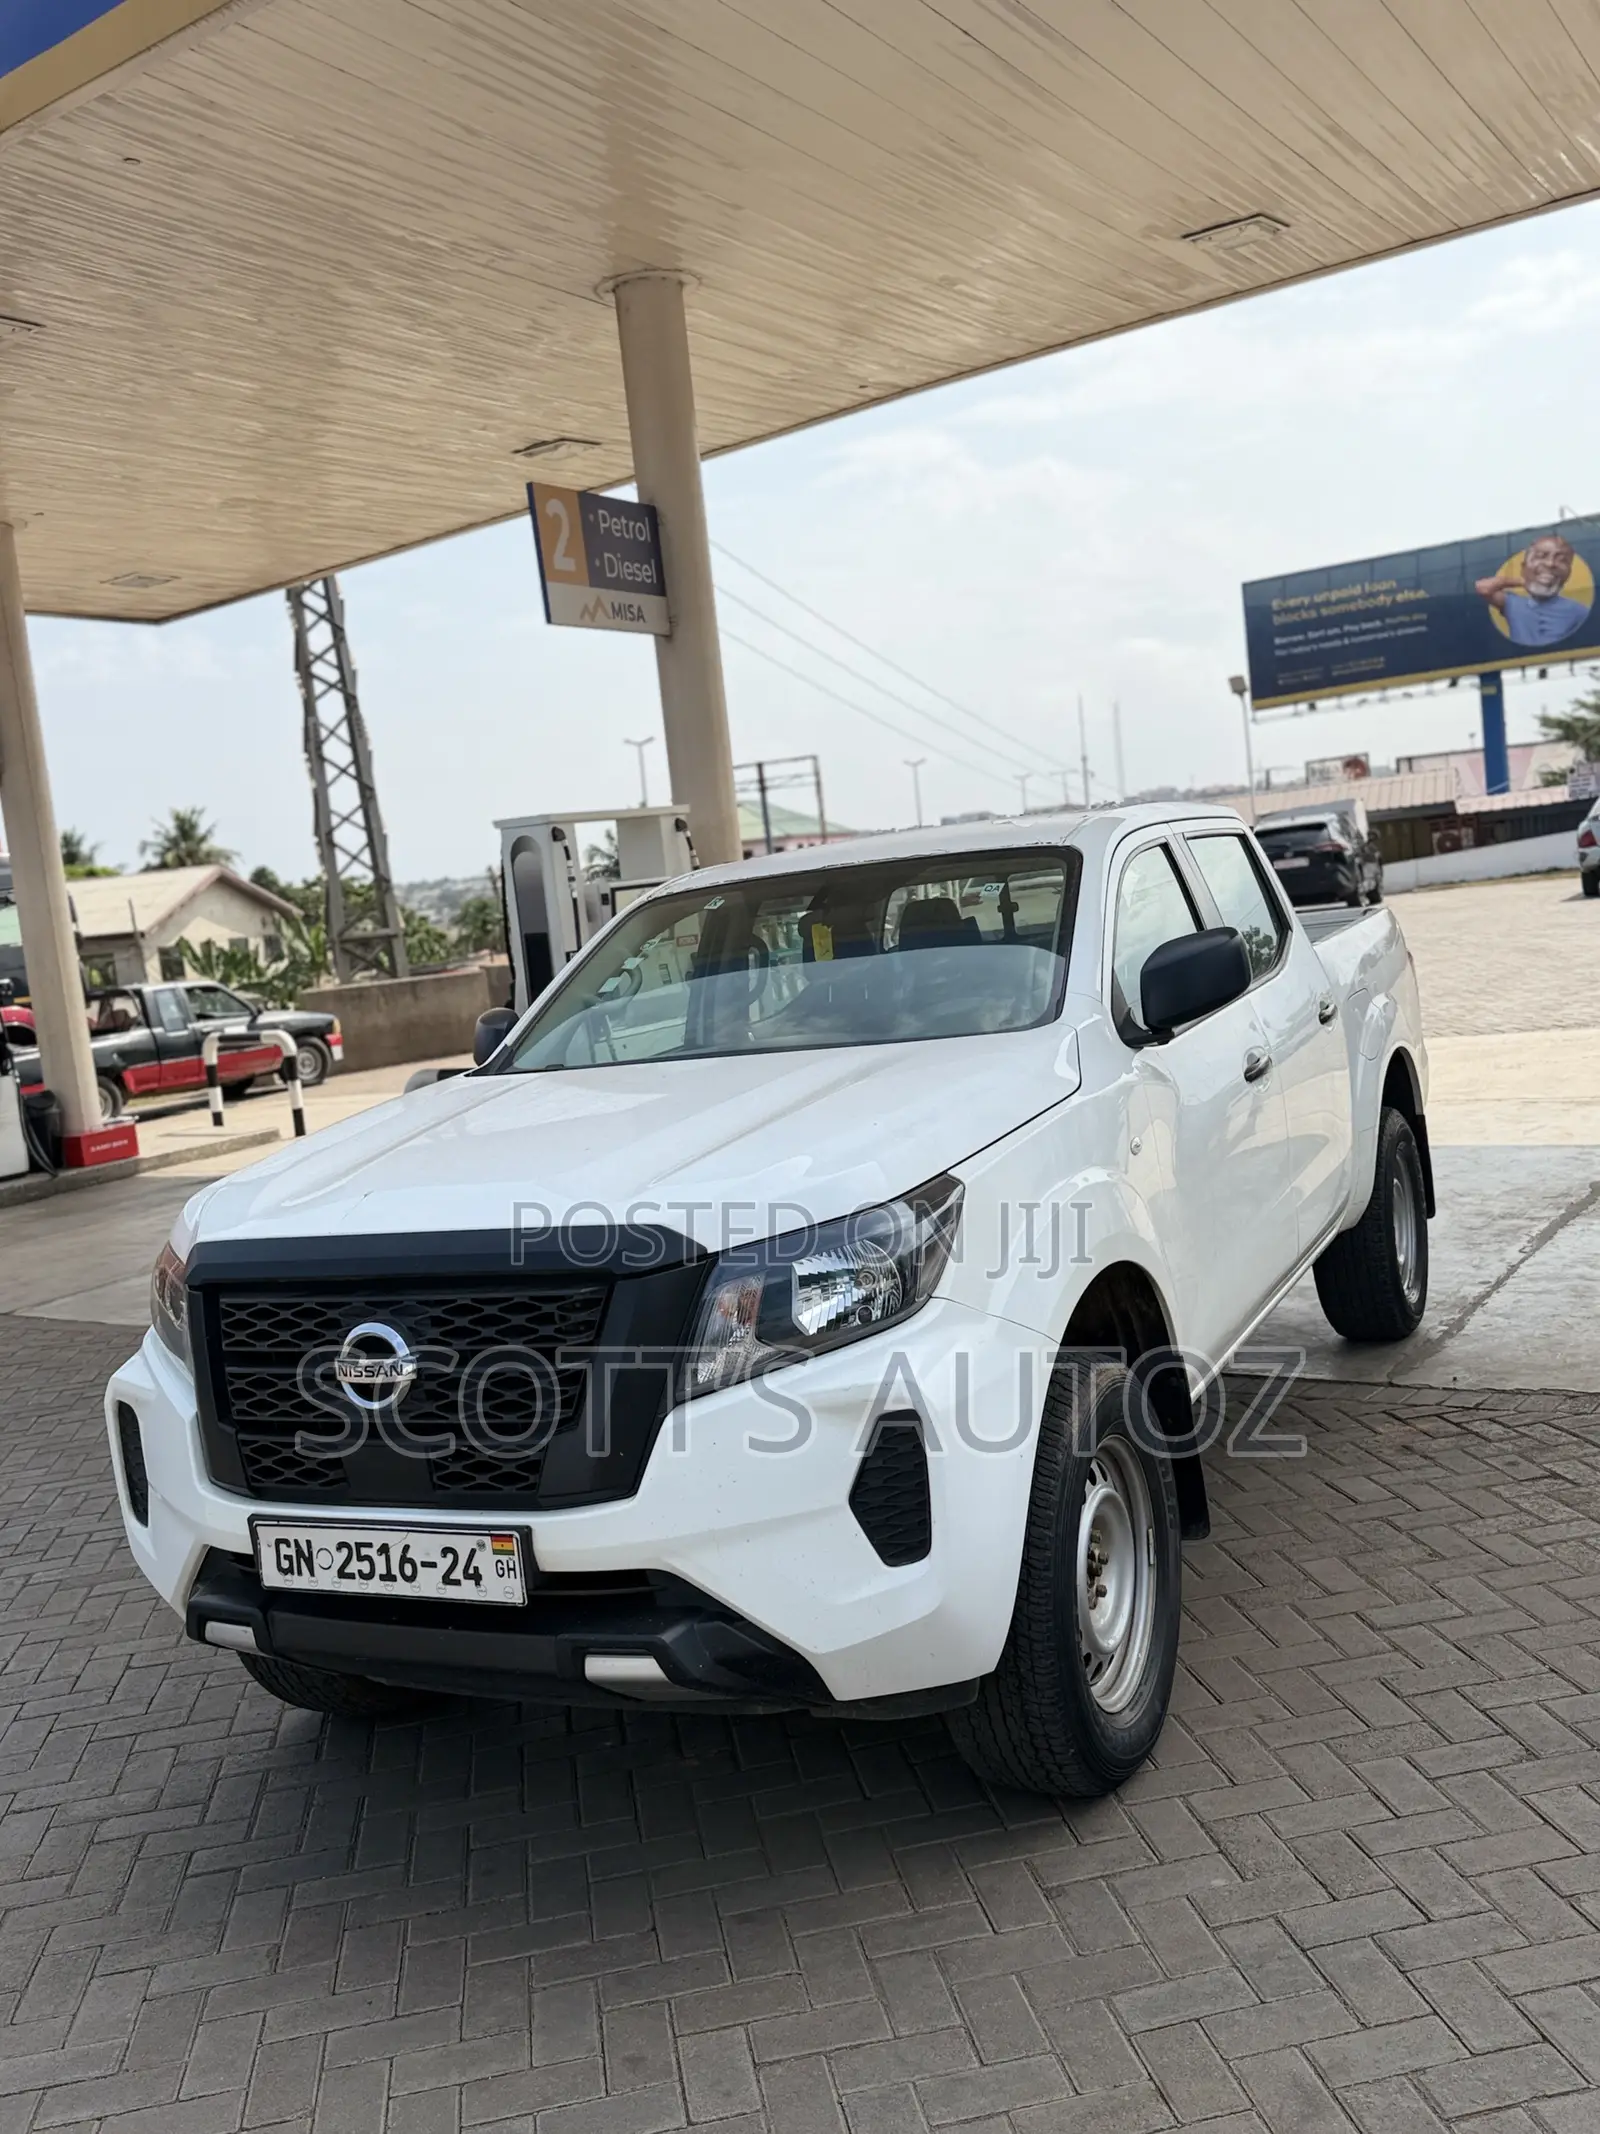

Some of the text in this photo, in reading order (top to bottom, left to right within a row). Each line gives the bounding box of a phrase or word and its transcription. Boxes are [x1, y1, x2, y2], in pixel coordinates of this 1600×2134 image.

[545, 498, 576, 572] 2
[597, 509, 651, 543] Petrol
[603, 552, 657, 584] Diesel
[610, 601, 646, 623] MISA
[338, 1363, 403, 1378] NISSAN
[274, 1538, 483, 1588] GN 2516-24
[495, 1558, 517, 1580] GH
